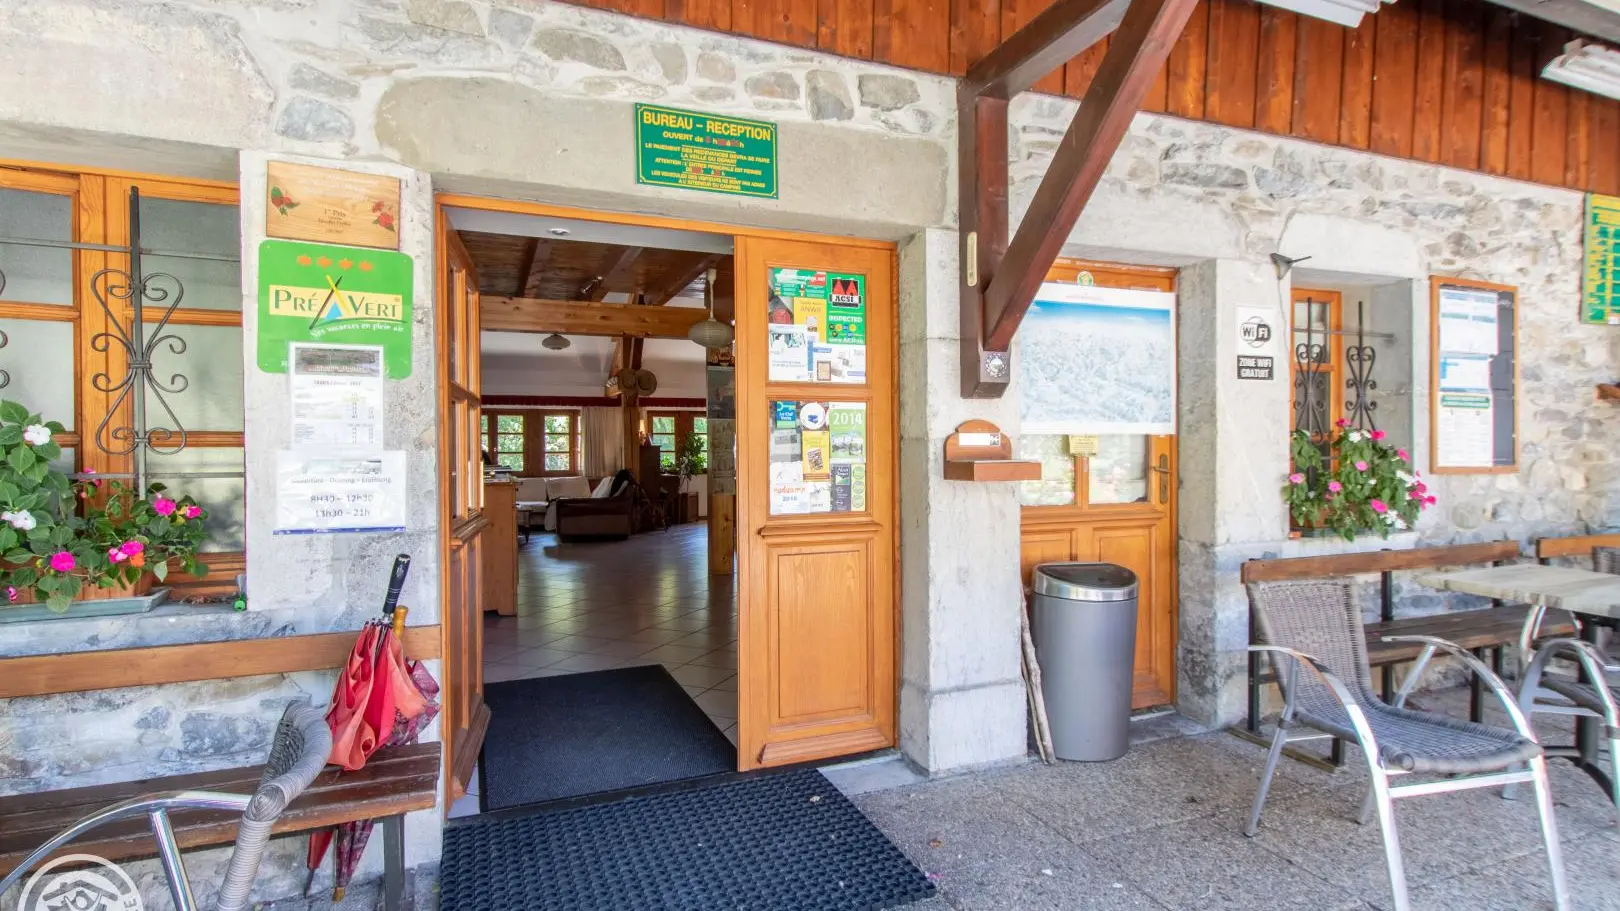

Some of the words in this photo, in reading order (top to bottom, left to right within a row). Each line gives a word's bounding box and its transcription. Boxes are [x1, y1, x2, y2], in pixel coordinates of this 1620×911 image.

[643, 111, 692, 129] BUREAU
[706, 120, 770, 140] RECEPTION
[662, 130, 692, 141] OUVERT
[694, 134, 703, 142] de
[274, 289, 318, 311] PRÉ
[347, 295, 399, 317] VERT
[1240, 358, 1257, 366] ZONE
[1241, 368, 1269, 377] GRATUIT
[833, 412, 863, 425] 2014
